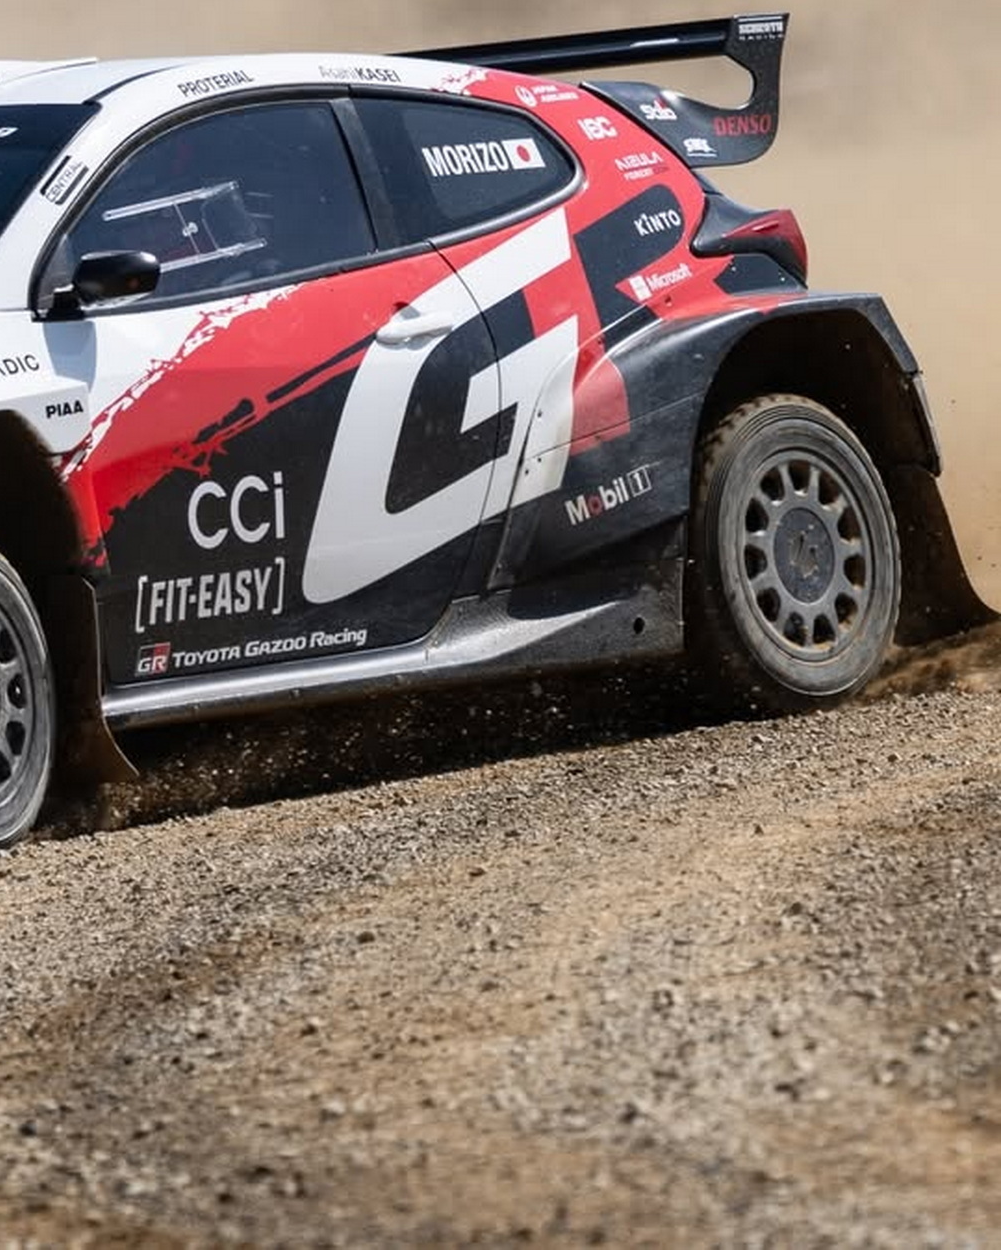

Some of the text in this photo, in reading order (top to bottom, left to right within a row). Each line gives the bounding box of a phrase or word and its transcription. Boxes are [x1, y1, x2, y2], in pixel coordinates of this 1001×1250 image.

[177, 70, 255, 97] PROTERIAL
[713, 114, 771, 137] DENSO
[421, 141, 509, 177] MORIZO
[45, 400, 84, 419] PIAA
[564, 476, 629, 526] Mobil
[137, 653, 169, 674] GR
[173, 646, 240, 667] TOYOTA
[309, 628, 367, 648] Racing
